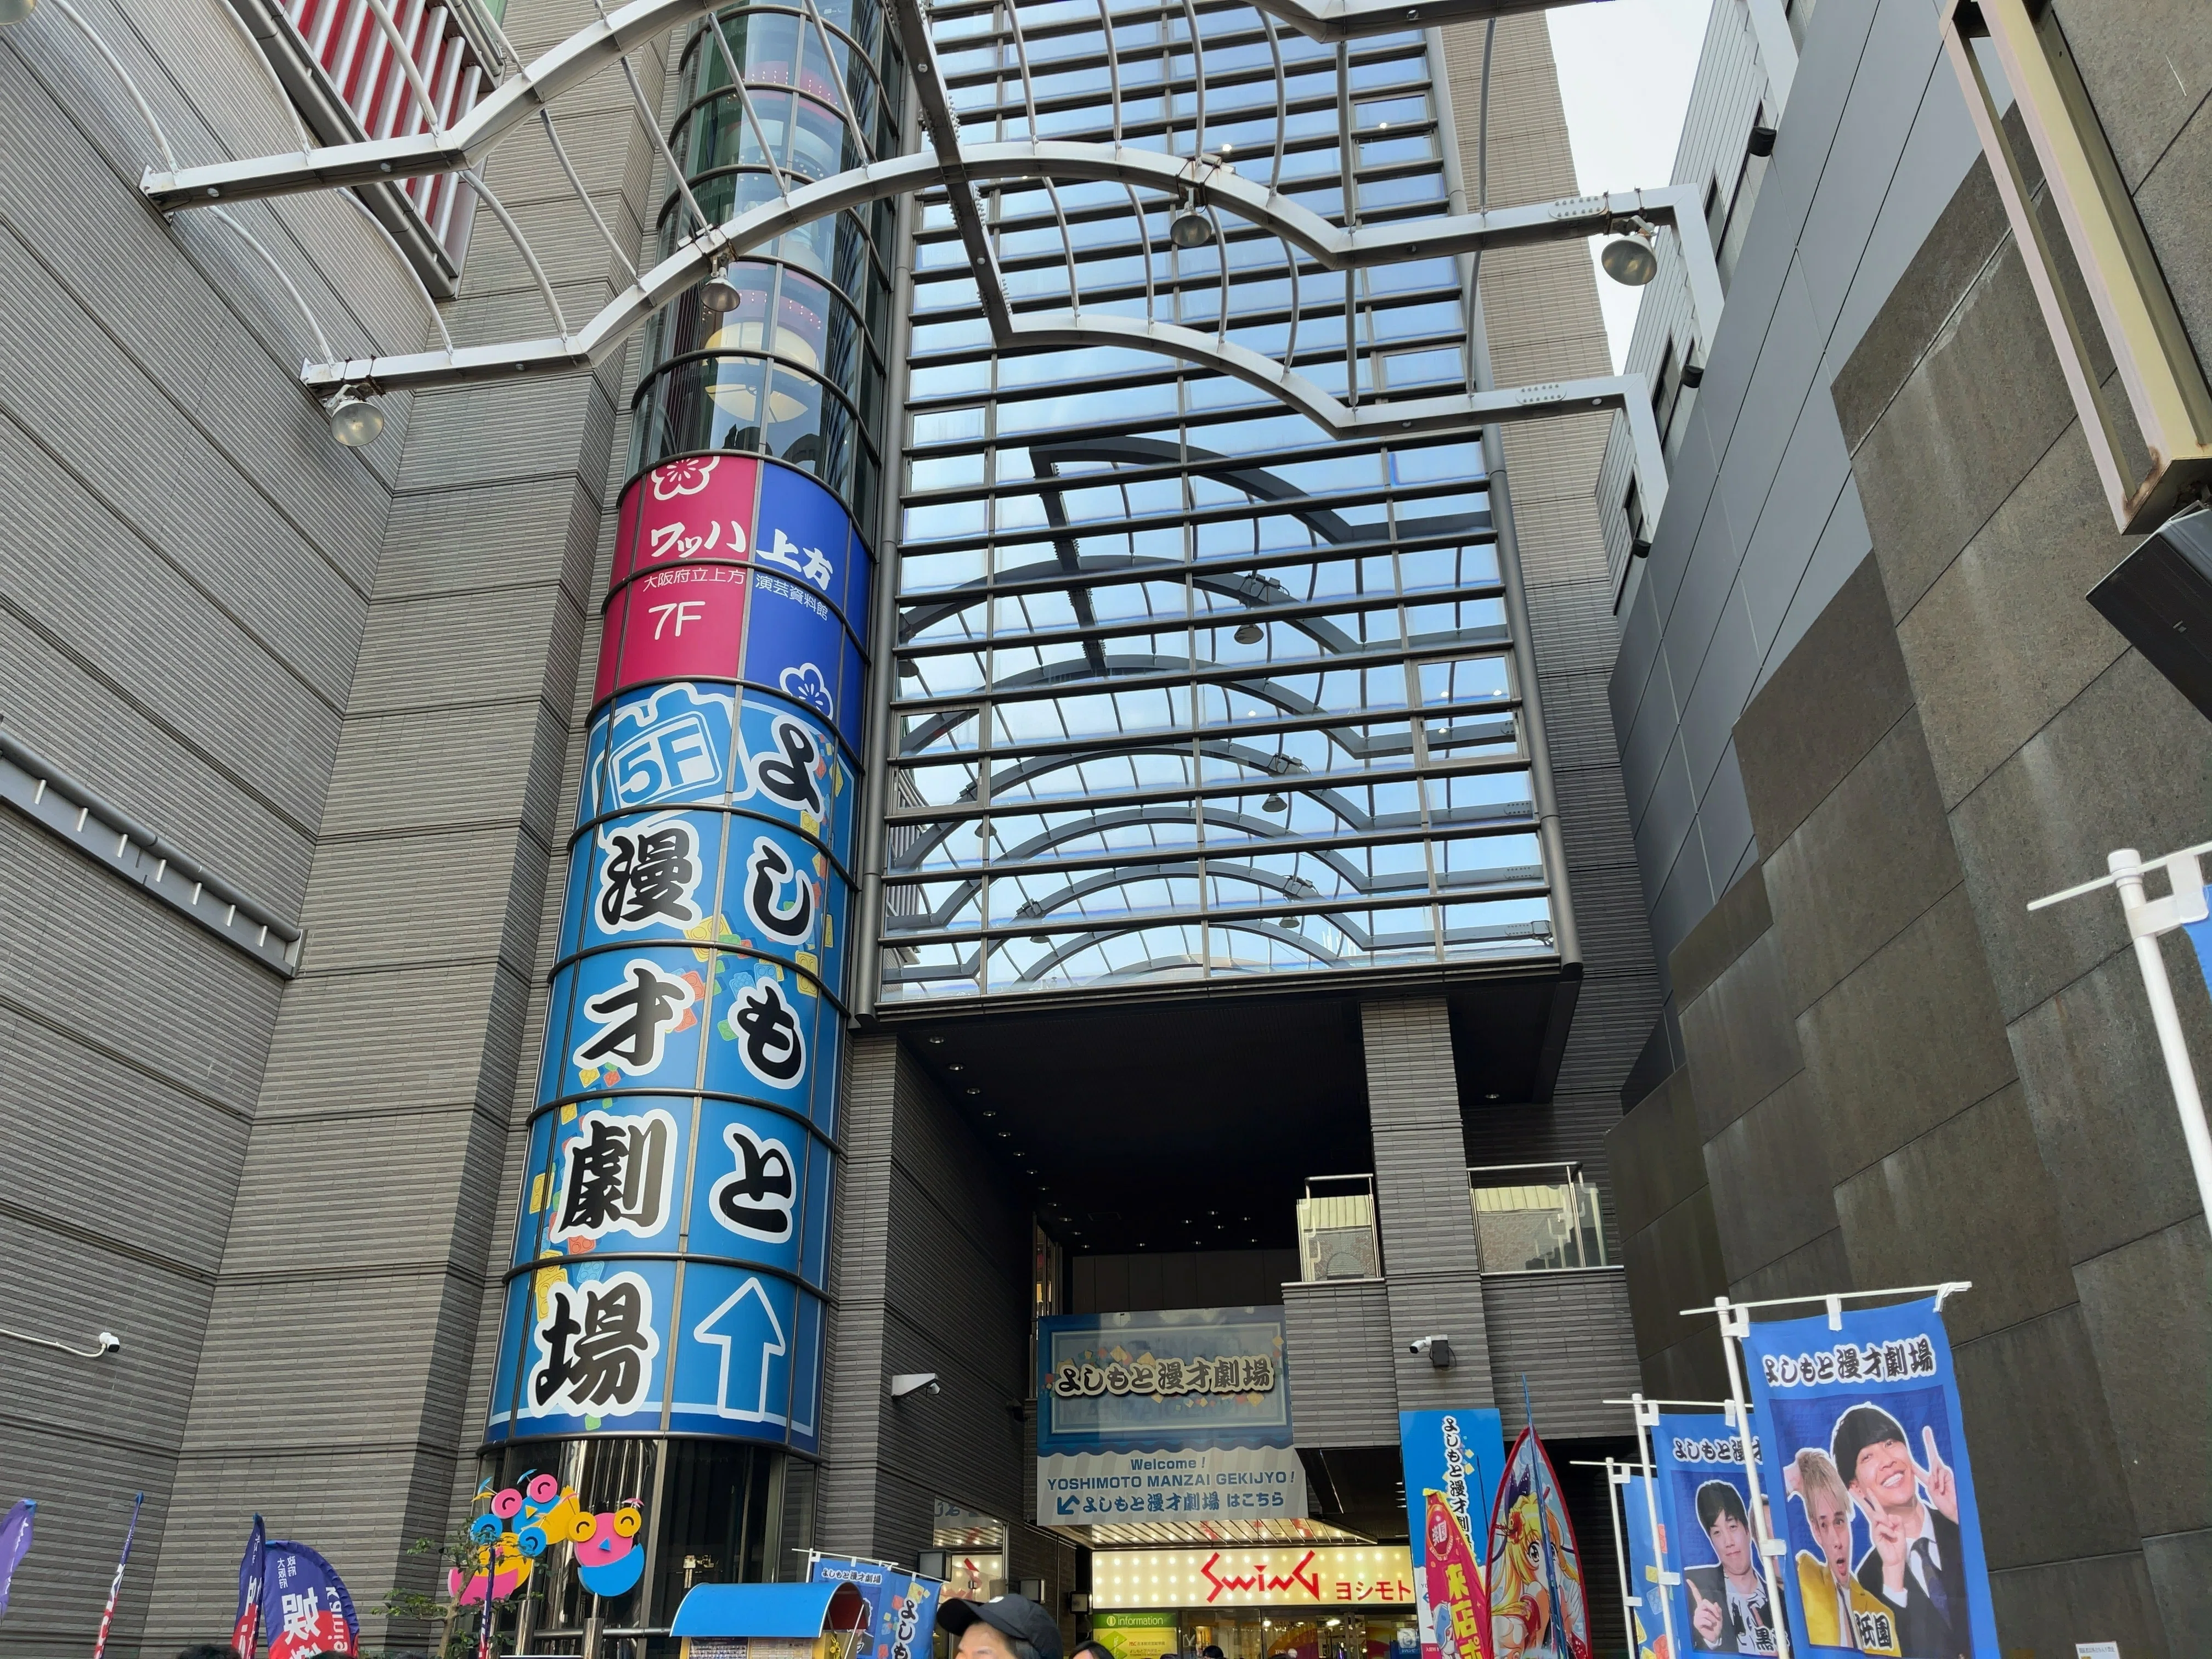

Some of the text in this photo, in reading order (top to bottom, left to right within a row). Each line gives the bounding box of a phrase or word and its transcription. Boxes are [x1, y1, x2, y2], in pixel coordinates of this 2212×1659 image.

[648, 601, 706, 640] 7F
[619, 727, 708, 803] 5F
[718, 721, 822, 1235] よしもと
[533, 827, 694, 1407] 漫才劇場
[1058, 1357, 1272, 1392] よしもと漫才劇場
[1764, 1339, 1933, 1383] よしもと漫才劇場
[1047, 1476, 1142, 1491] YOSHIMOTO
[1148, 1473, 1210, 1488] MANZAI
[1444, 1418, 1472, 1549] よしもと漫才劇
[1083, 1492, 1284, 1513] よしもと漫才劇場 はこちら
[822, 1571, 881, 1584] よしもと漫才劇場
[1336, 1580, 1412, 1601] ヨシモト
[1118, 1615, 1164, 1626] information
